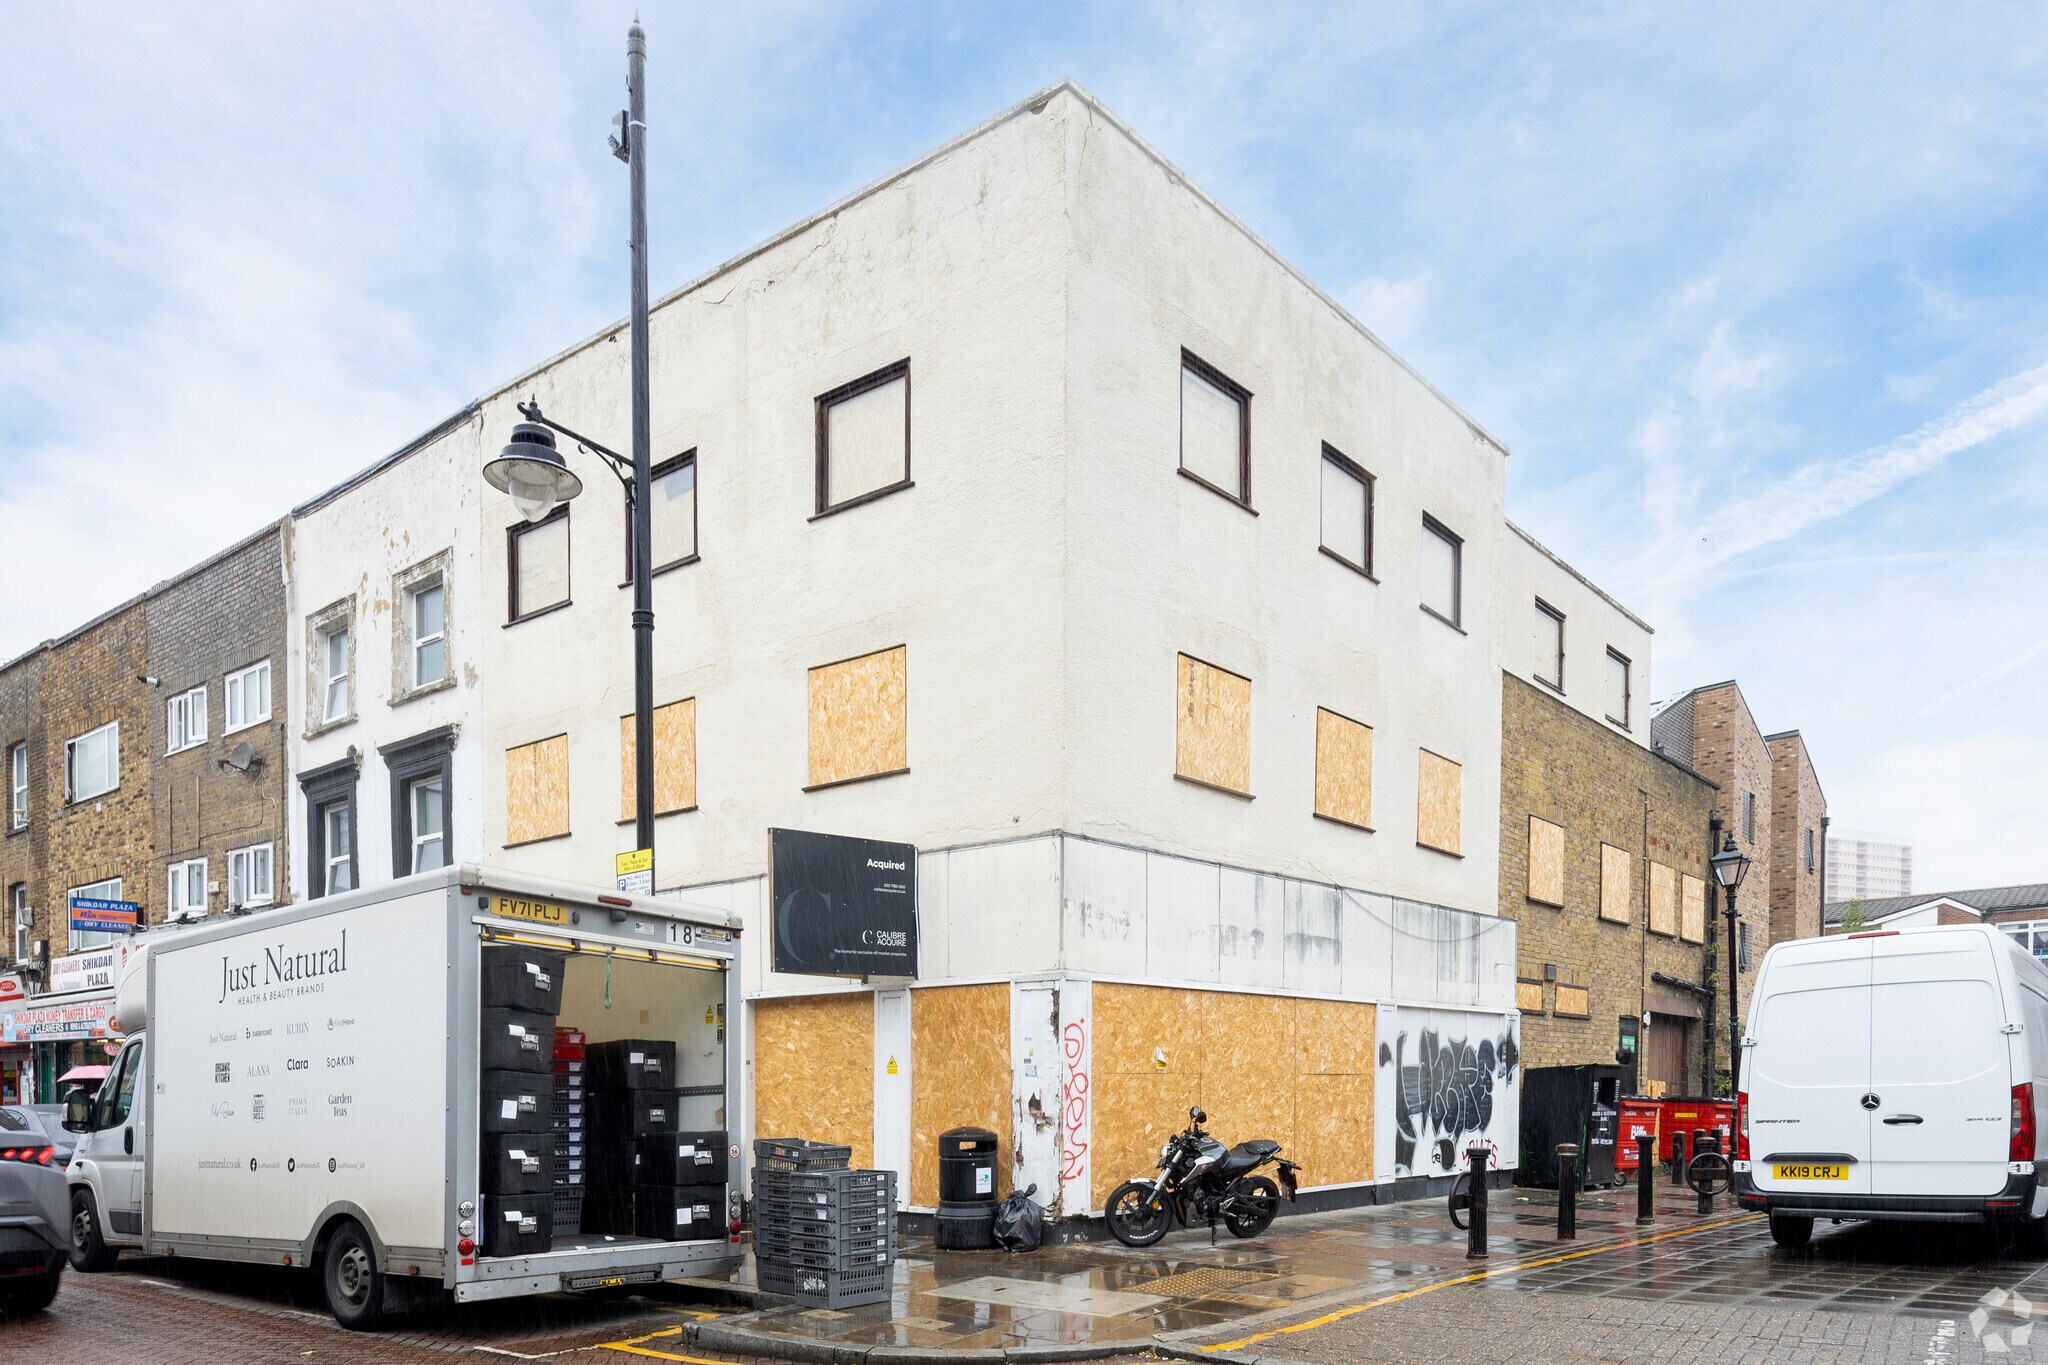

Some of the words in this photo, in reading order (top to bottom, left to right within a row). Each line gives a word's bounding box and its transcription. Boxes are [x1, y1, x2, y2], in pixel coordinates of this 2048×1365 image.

[867, 859, 905, 871] Acquired
[80, 910, 96, 918] Ria
[500, 898, 530, 916] FV71
[535, 904, 560, 920] PLJ
[670, 923, 692, 944] 18
[877, 931, 906, 939] CALIBRE
[877, 938, 906, 946] ACQUIRE
[61, 960, 80, 974] CLEANERS
[82, 955, 113, 970] SHIKDAR
[219, 956, 257, 1004] Just
[264, 928, 347, 985] Natural
[87, 972, 109, 986] PLAZA
[238, 994, 260, 1005] HEALTH
[263, 992, 267, 1001] &
[270, 989, 294, 1000] BEAUTY
[297, 983, 325, 995] BRANDS
[15, 1012, 32, 1024] SHIKDAR
[33, 1011, 45, 1023] PLAZA
[46, 1009, 60, 1022] MONEY
[62, 1008, 84, 1021] TRANSFER
[90, 1006, 105, 1019] CARGO
[24, 1024, 34, 1034] DRY
[36, 1022, 64, 1033] CLEANERS
[252, 1027, 272, 1037] balanced
[209, 1034, 219, 1045] Just
[220, 1031, 237, 1043] Natural
[215, 1062, 230, 1072] ORGANIC
[287, 1059, 309, 1070] Clara
[247, 1065, 270, 1077] ALANA
[215, 1073, 230, 1083] KITCHEN
[328, 1093, 352, 1105] Garden
[289, 1108, 308, 1116] ITALIA
[333, 1107, 347, 1116] Teas
[198, 1158, 241, 1170] justnatural.co.uk
[1781, 1166, 1810, 1178] KK19
[1814, 1166, 1839, 1178] CRJ
